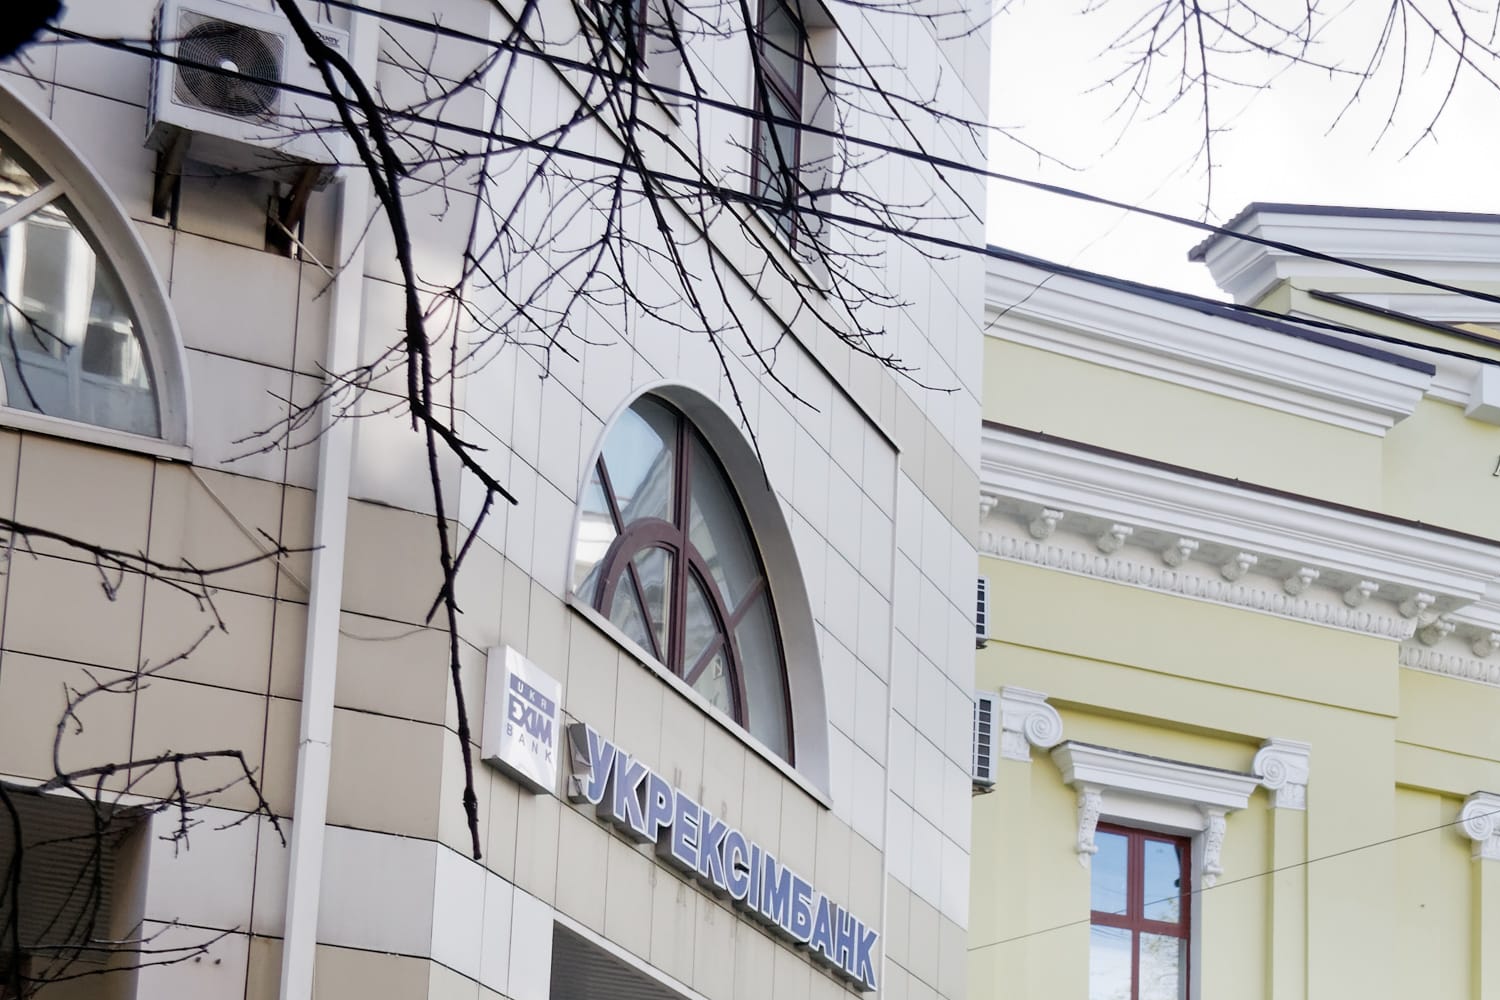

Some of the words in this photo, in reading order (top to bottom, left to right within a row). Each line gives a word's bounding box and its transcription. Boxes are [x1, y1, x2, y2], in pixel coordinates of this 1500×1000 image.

[517, 681, 547, 710] UKR
[506, 722, 552, 763] BANK
[508, 693, 553, 749] EXIM
[583, 723, 880, 991] УКРЕКСІМБАНК
